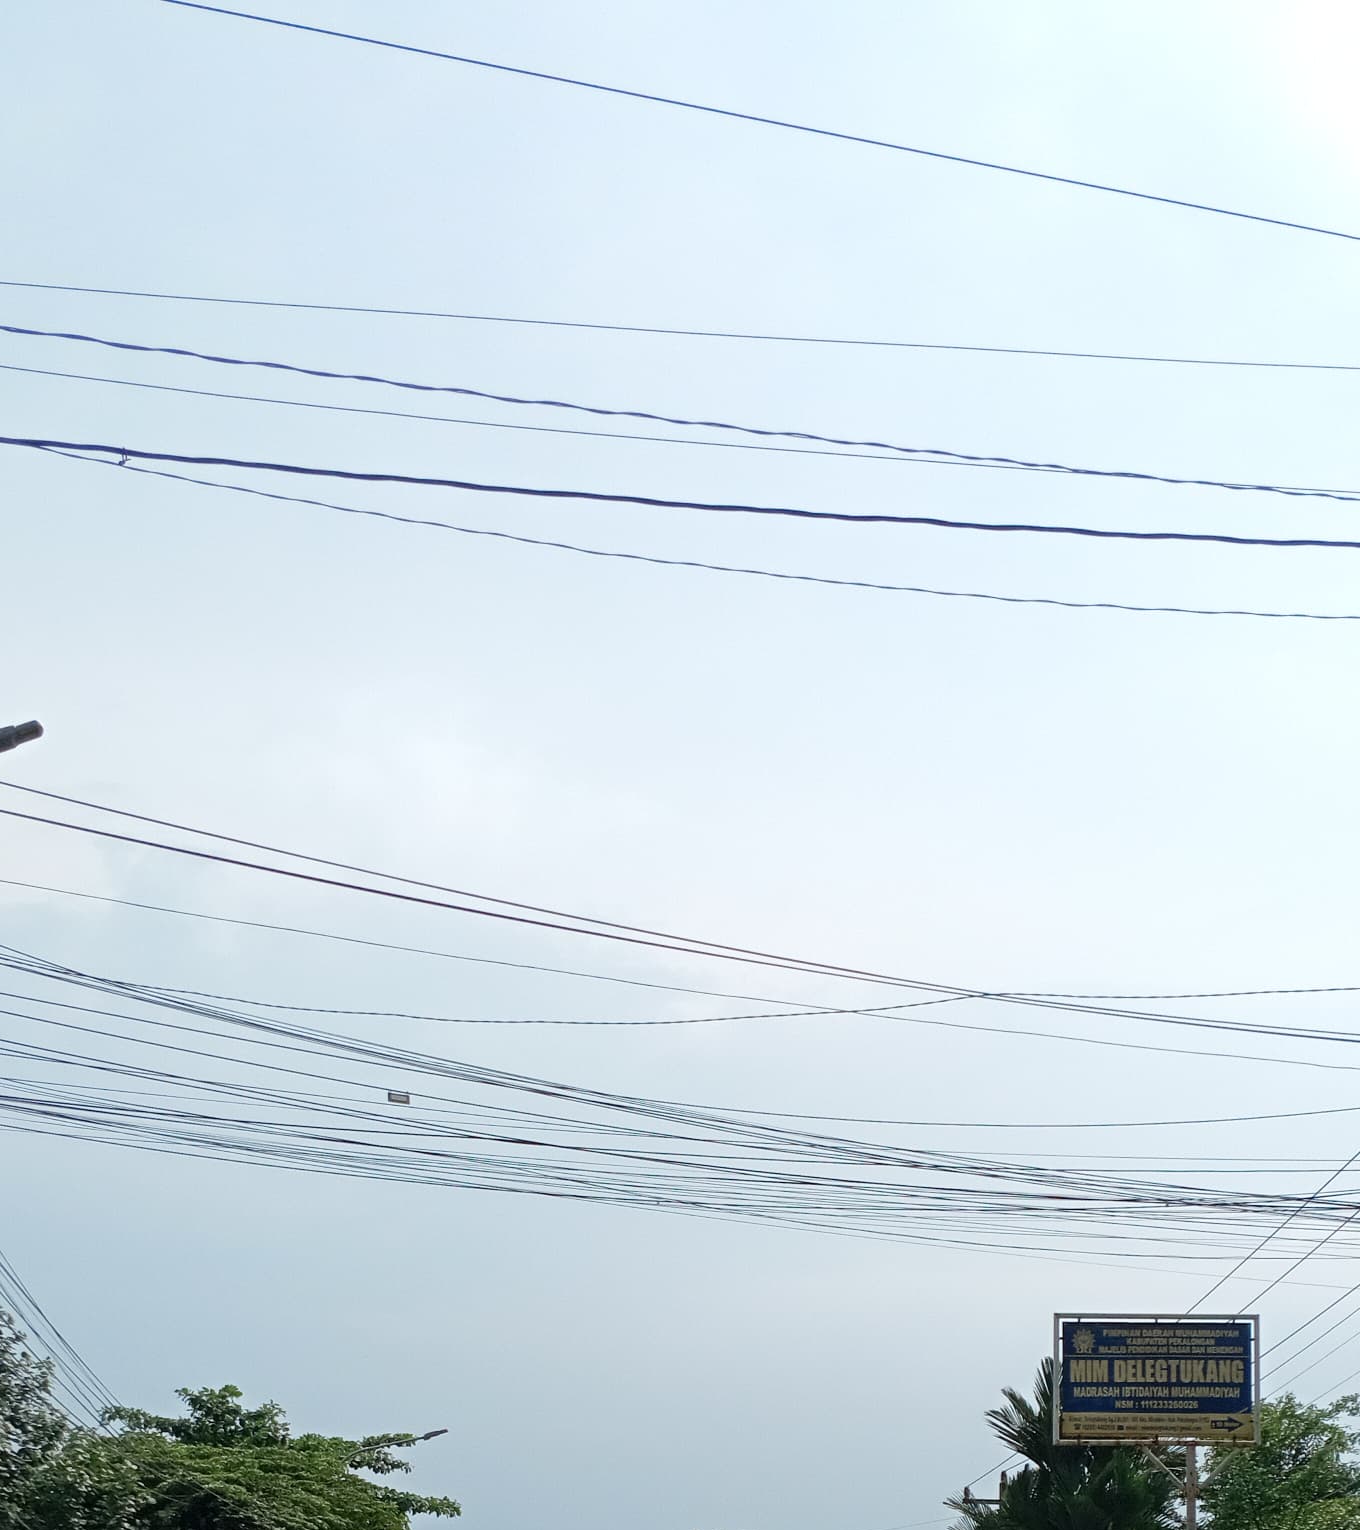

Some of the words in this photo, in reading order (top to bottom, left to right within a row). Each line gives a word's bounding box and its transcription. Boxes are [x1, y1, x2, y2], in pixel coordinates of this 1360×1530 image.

[1070, 1359, 1109, 1383] MIM
[1114, 1359, 1244, 1383] DELEGTUKANG
[1073, 1386, 1120, 1398] MADRASAH
[1121, 1387, 1169, 1398] IBTIDAIYAH
[1170, 1387, 1240, 1398] MUHAMMADIYAH
[1115, 1400, 1134, 1409] NSM
